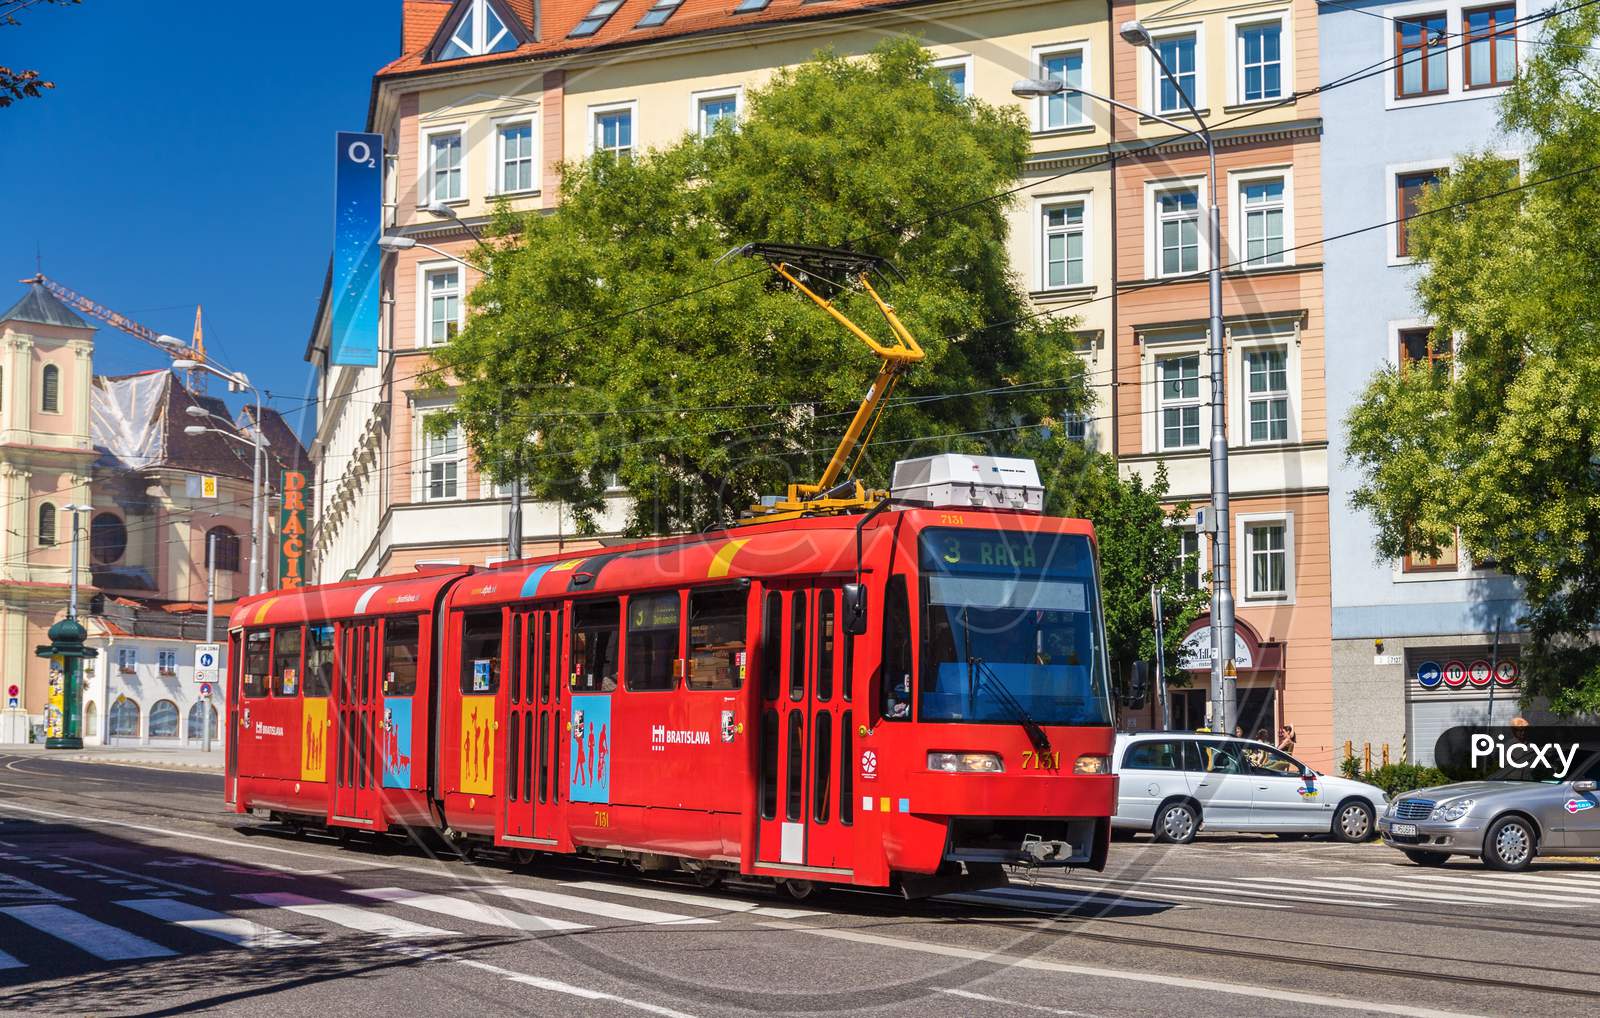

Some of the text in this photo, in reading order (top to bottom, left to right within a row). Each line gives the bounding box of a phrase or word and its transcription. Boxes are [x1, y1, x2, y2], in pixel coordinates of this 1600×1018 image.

[348, 141, 376, 168] O2
[941, 514, 963, 525] 7131
[943, 537, 961, 563] 3
[1450, 669, 1461, 679] 10
[666, 730, 711, 745] BRATISLAVA
[1022, 750, 1060, 769] 7131
[594, 811, 609, 828] 7131
